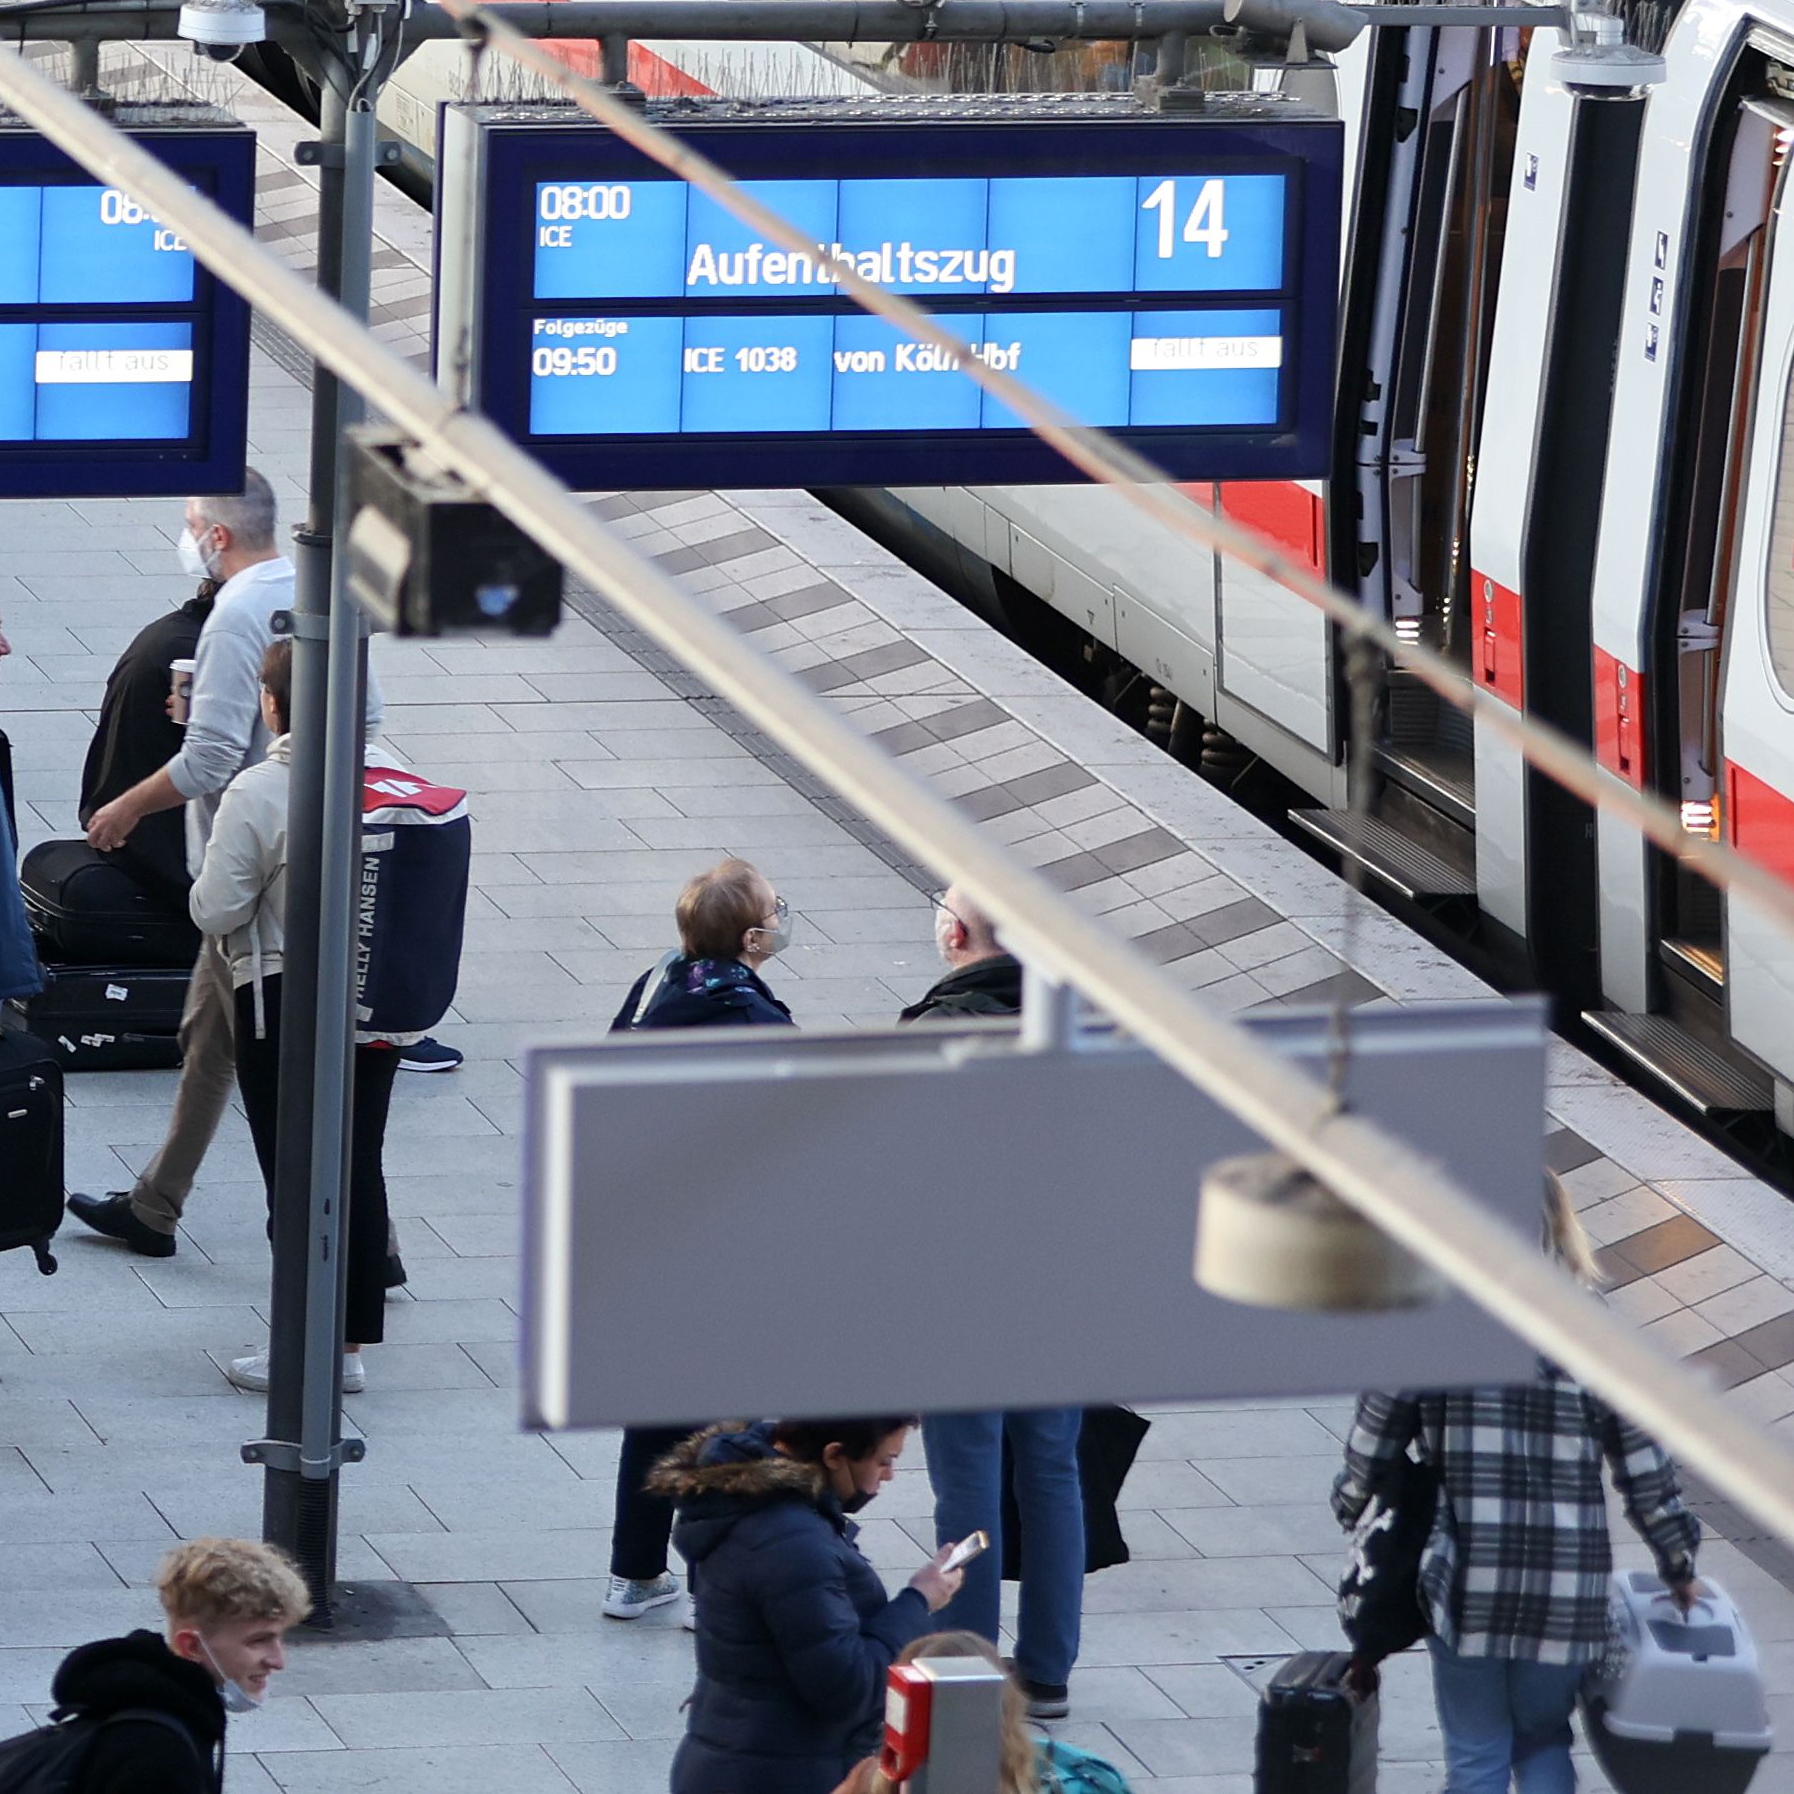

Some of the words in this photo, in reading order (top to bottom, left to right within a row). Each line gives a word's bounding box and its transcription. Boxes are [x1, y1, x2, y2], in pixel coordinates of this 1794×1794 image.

[100, 189, 164, 225] 08:
[540, 185, 631, 220] 08:00
[1141, 179, 1229, 259] 14
[540, 225, 573, 248] ICE
[534, 319, 628, 338] Folgezüge
[124, 354, 169, 371] aus
[532, 346, 617, 376] 09:50
[684, 346, 726, 373] ICE
[734, 346, 797, 372] 1038
[833, 350, 886, 373] von
[1216, 341, 1259, 357] aus
[358, 857, 380, 937] HANSEN
